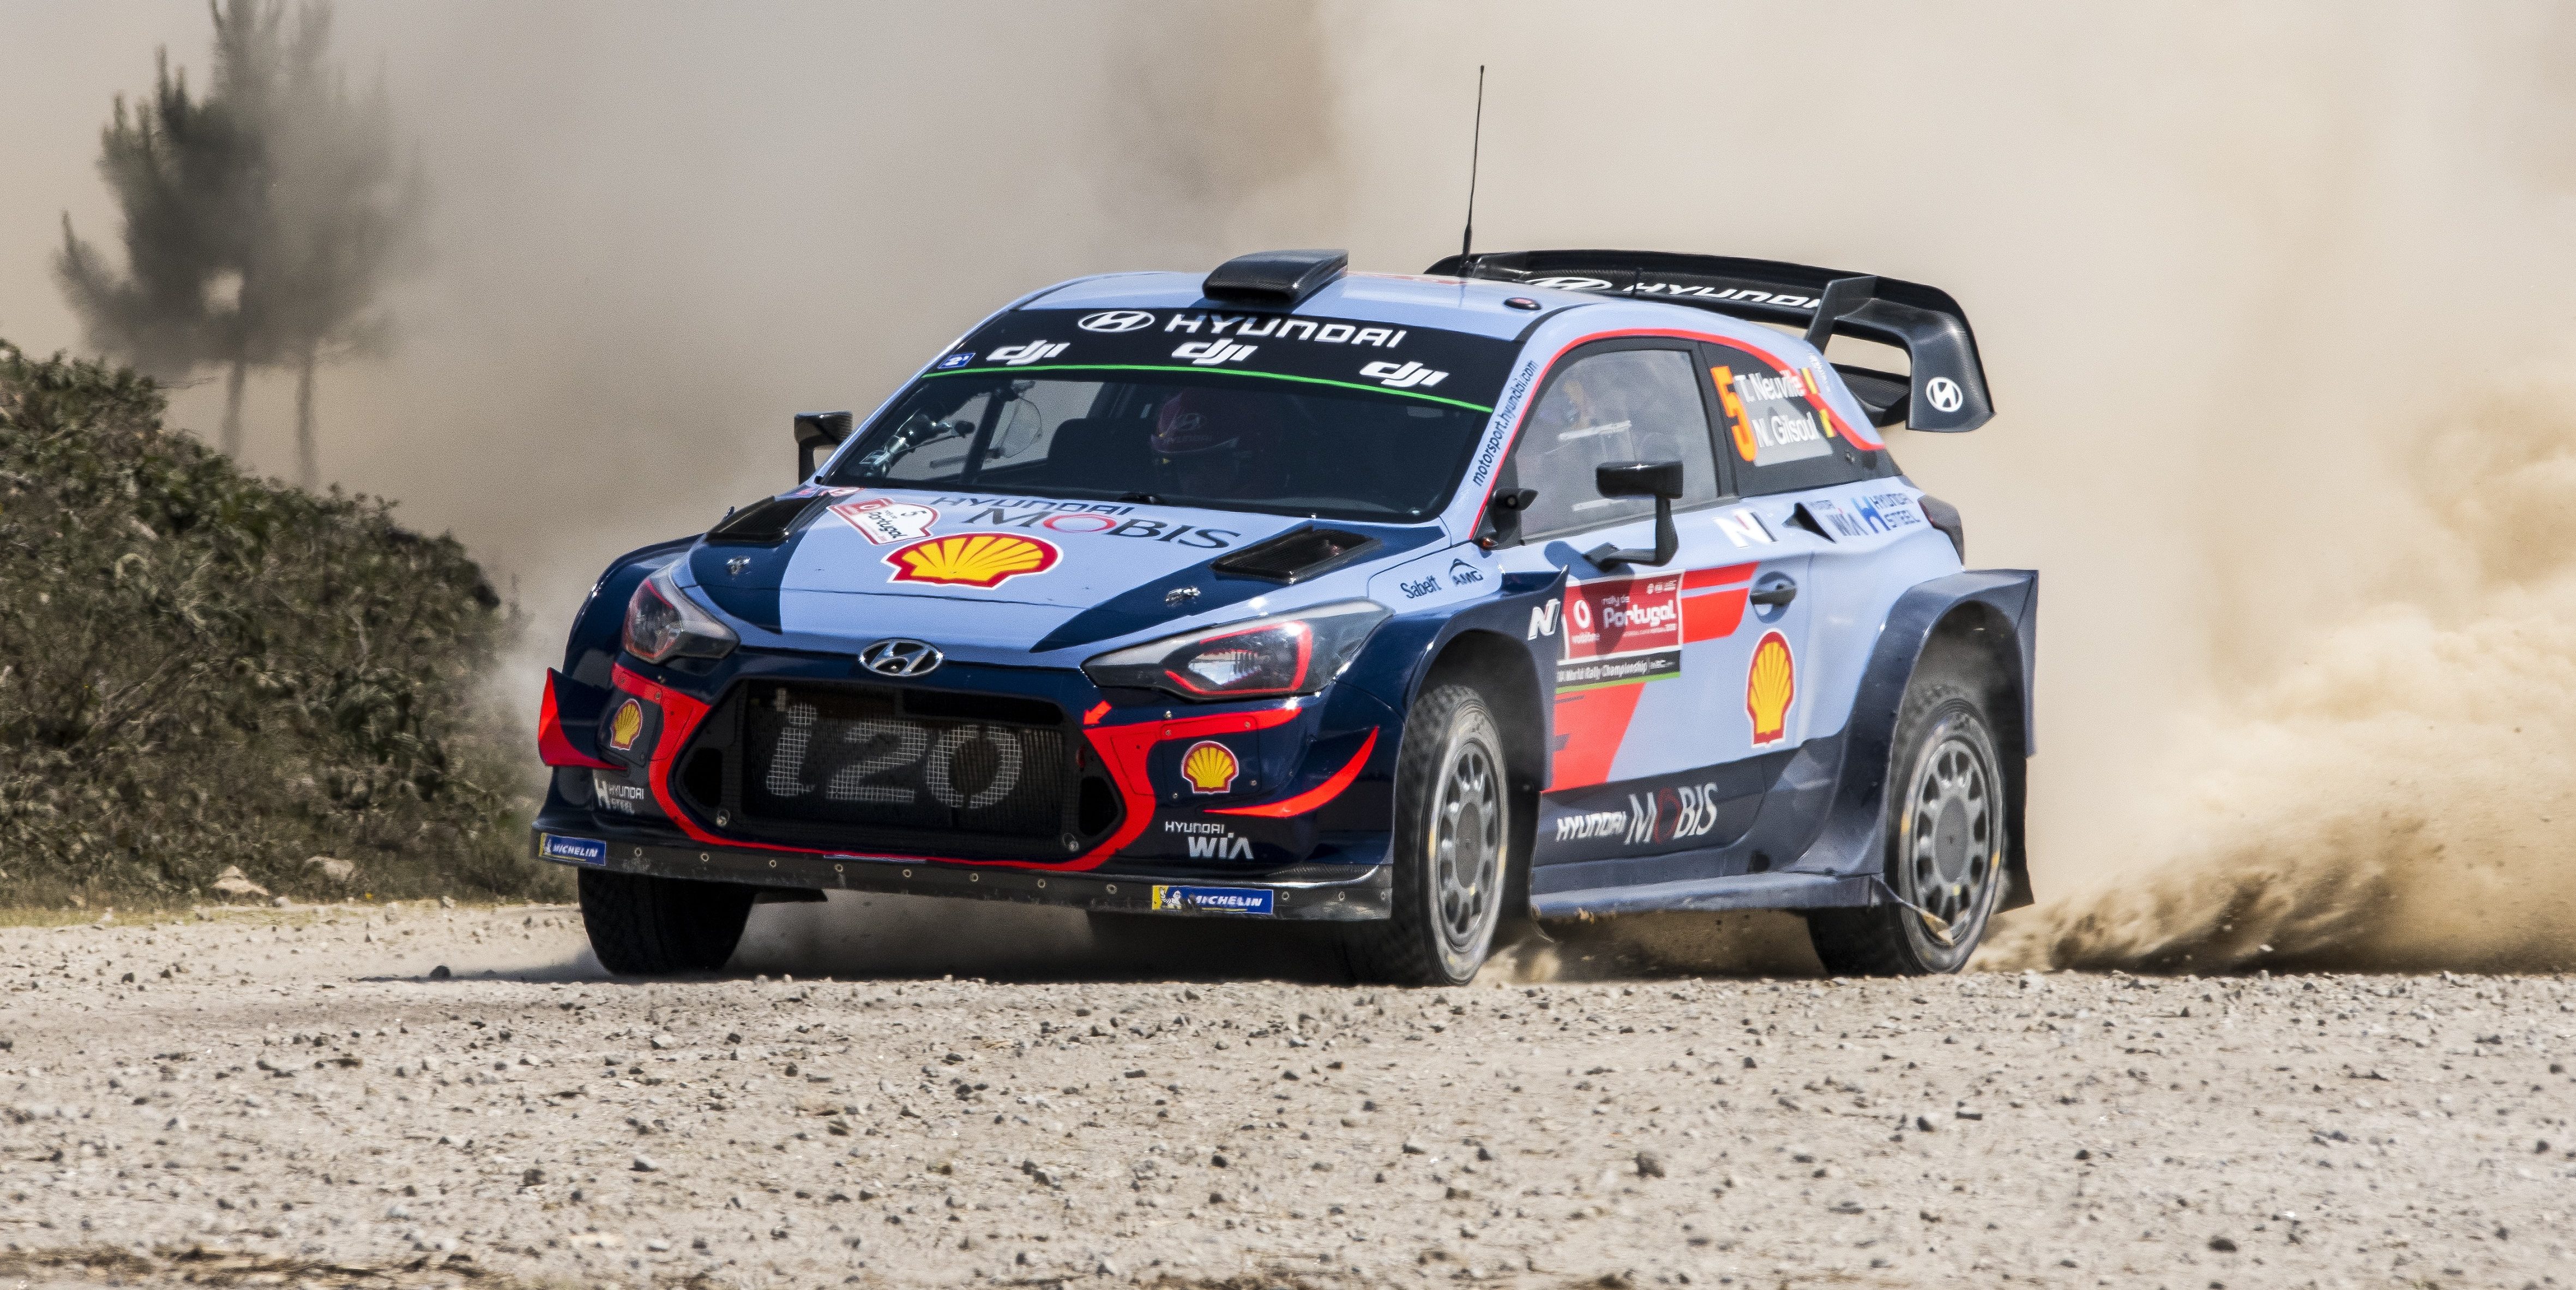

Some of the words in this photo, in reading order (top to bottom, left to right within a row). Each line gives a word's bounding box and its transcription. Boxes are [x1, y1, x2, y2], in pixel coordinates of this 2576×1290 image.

[1622, 282, 1820, 309] HYUND
[1164, 314, 1407, 348] HYUNDAI
[1748, 370, 1807, 401] Neuville
[1472, 360, 1539, 487] motorsport.hyundai.com
[1710, 365, 1759, 462] 5
[1771, 412, 1821, 445] Gilsoul
[929, 496, 1135, 516] HYUNDAI
[961, 508, 1242, 548] MOBIS
[1400, 575, 1442, 599] Sabelt
[1602, 599, 1677, 629] Portugal
[1585, 665, 1602, 680] Rally
[1602, 660, 1648, 678] Championship
[766, 703, 1022, 809] i20
[609, 783, 644, 800] HYUNDAI
[1165, 821, 1225, 834] HYUNDAI
[1555, 811, 1627, 842] HYUNDAI
[1623, 782, 1718, 846] MOBIS
[552, 845, 598, 858] MICHELIN
